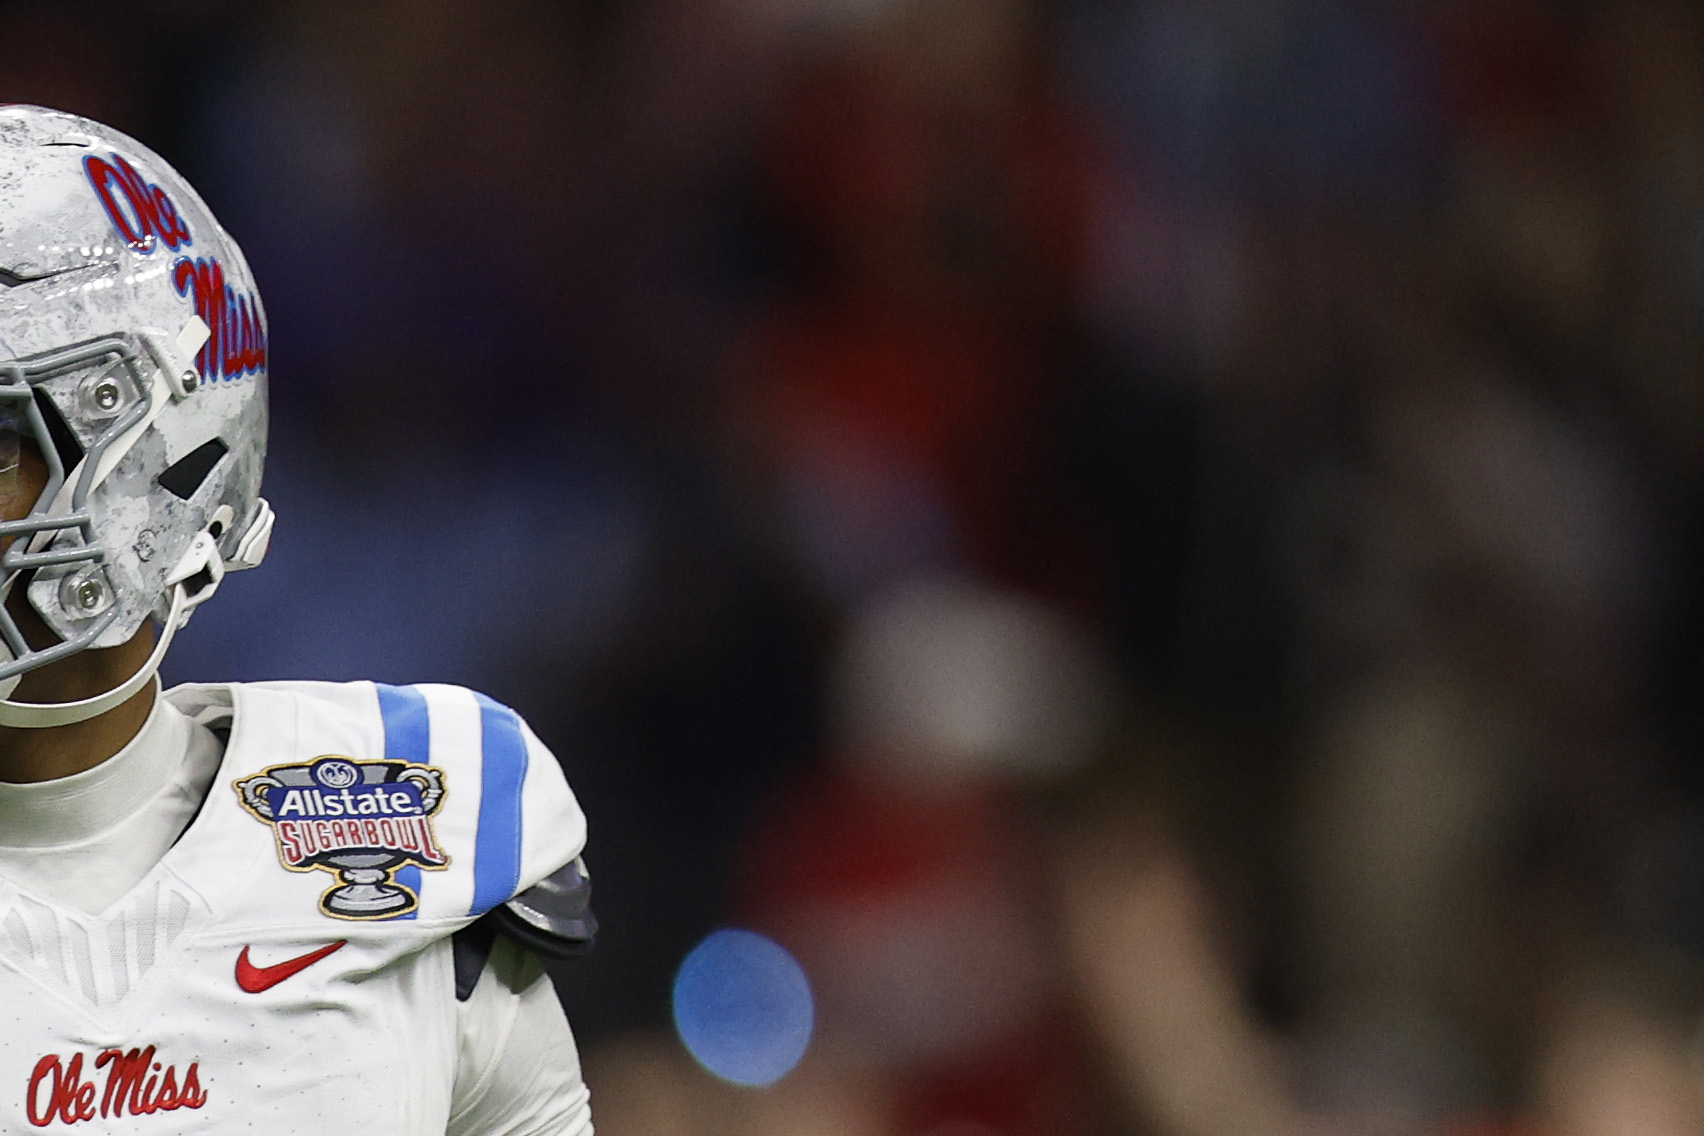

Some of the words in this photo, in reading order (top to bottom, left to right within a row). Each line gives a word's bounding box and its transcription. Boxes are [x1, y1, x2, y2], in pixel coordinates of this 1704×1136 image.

[83, 152, 192, 254] Ole
[172, 256, 266, 384] Miss
[278, 787, 415, 816] Allstate
[27, 1052, 96, 1127] Ole
[95, 1044, 208, 1120] Miss
